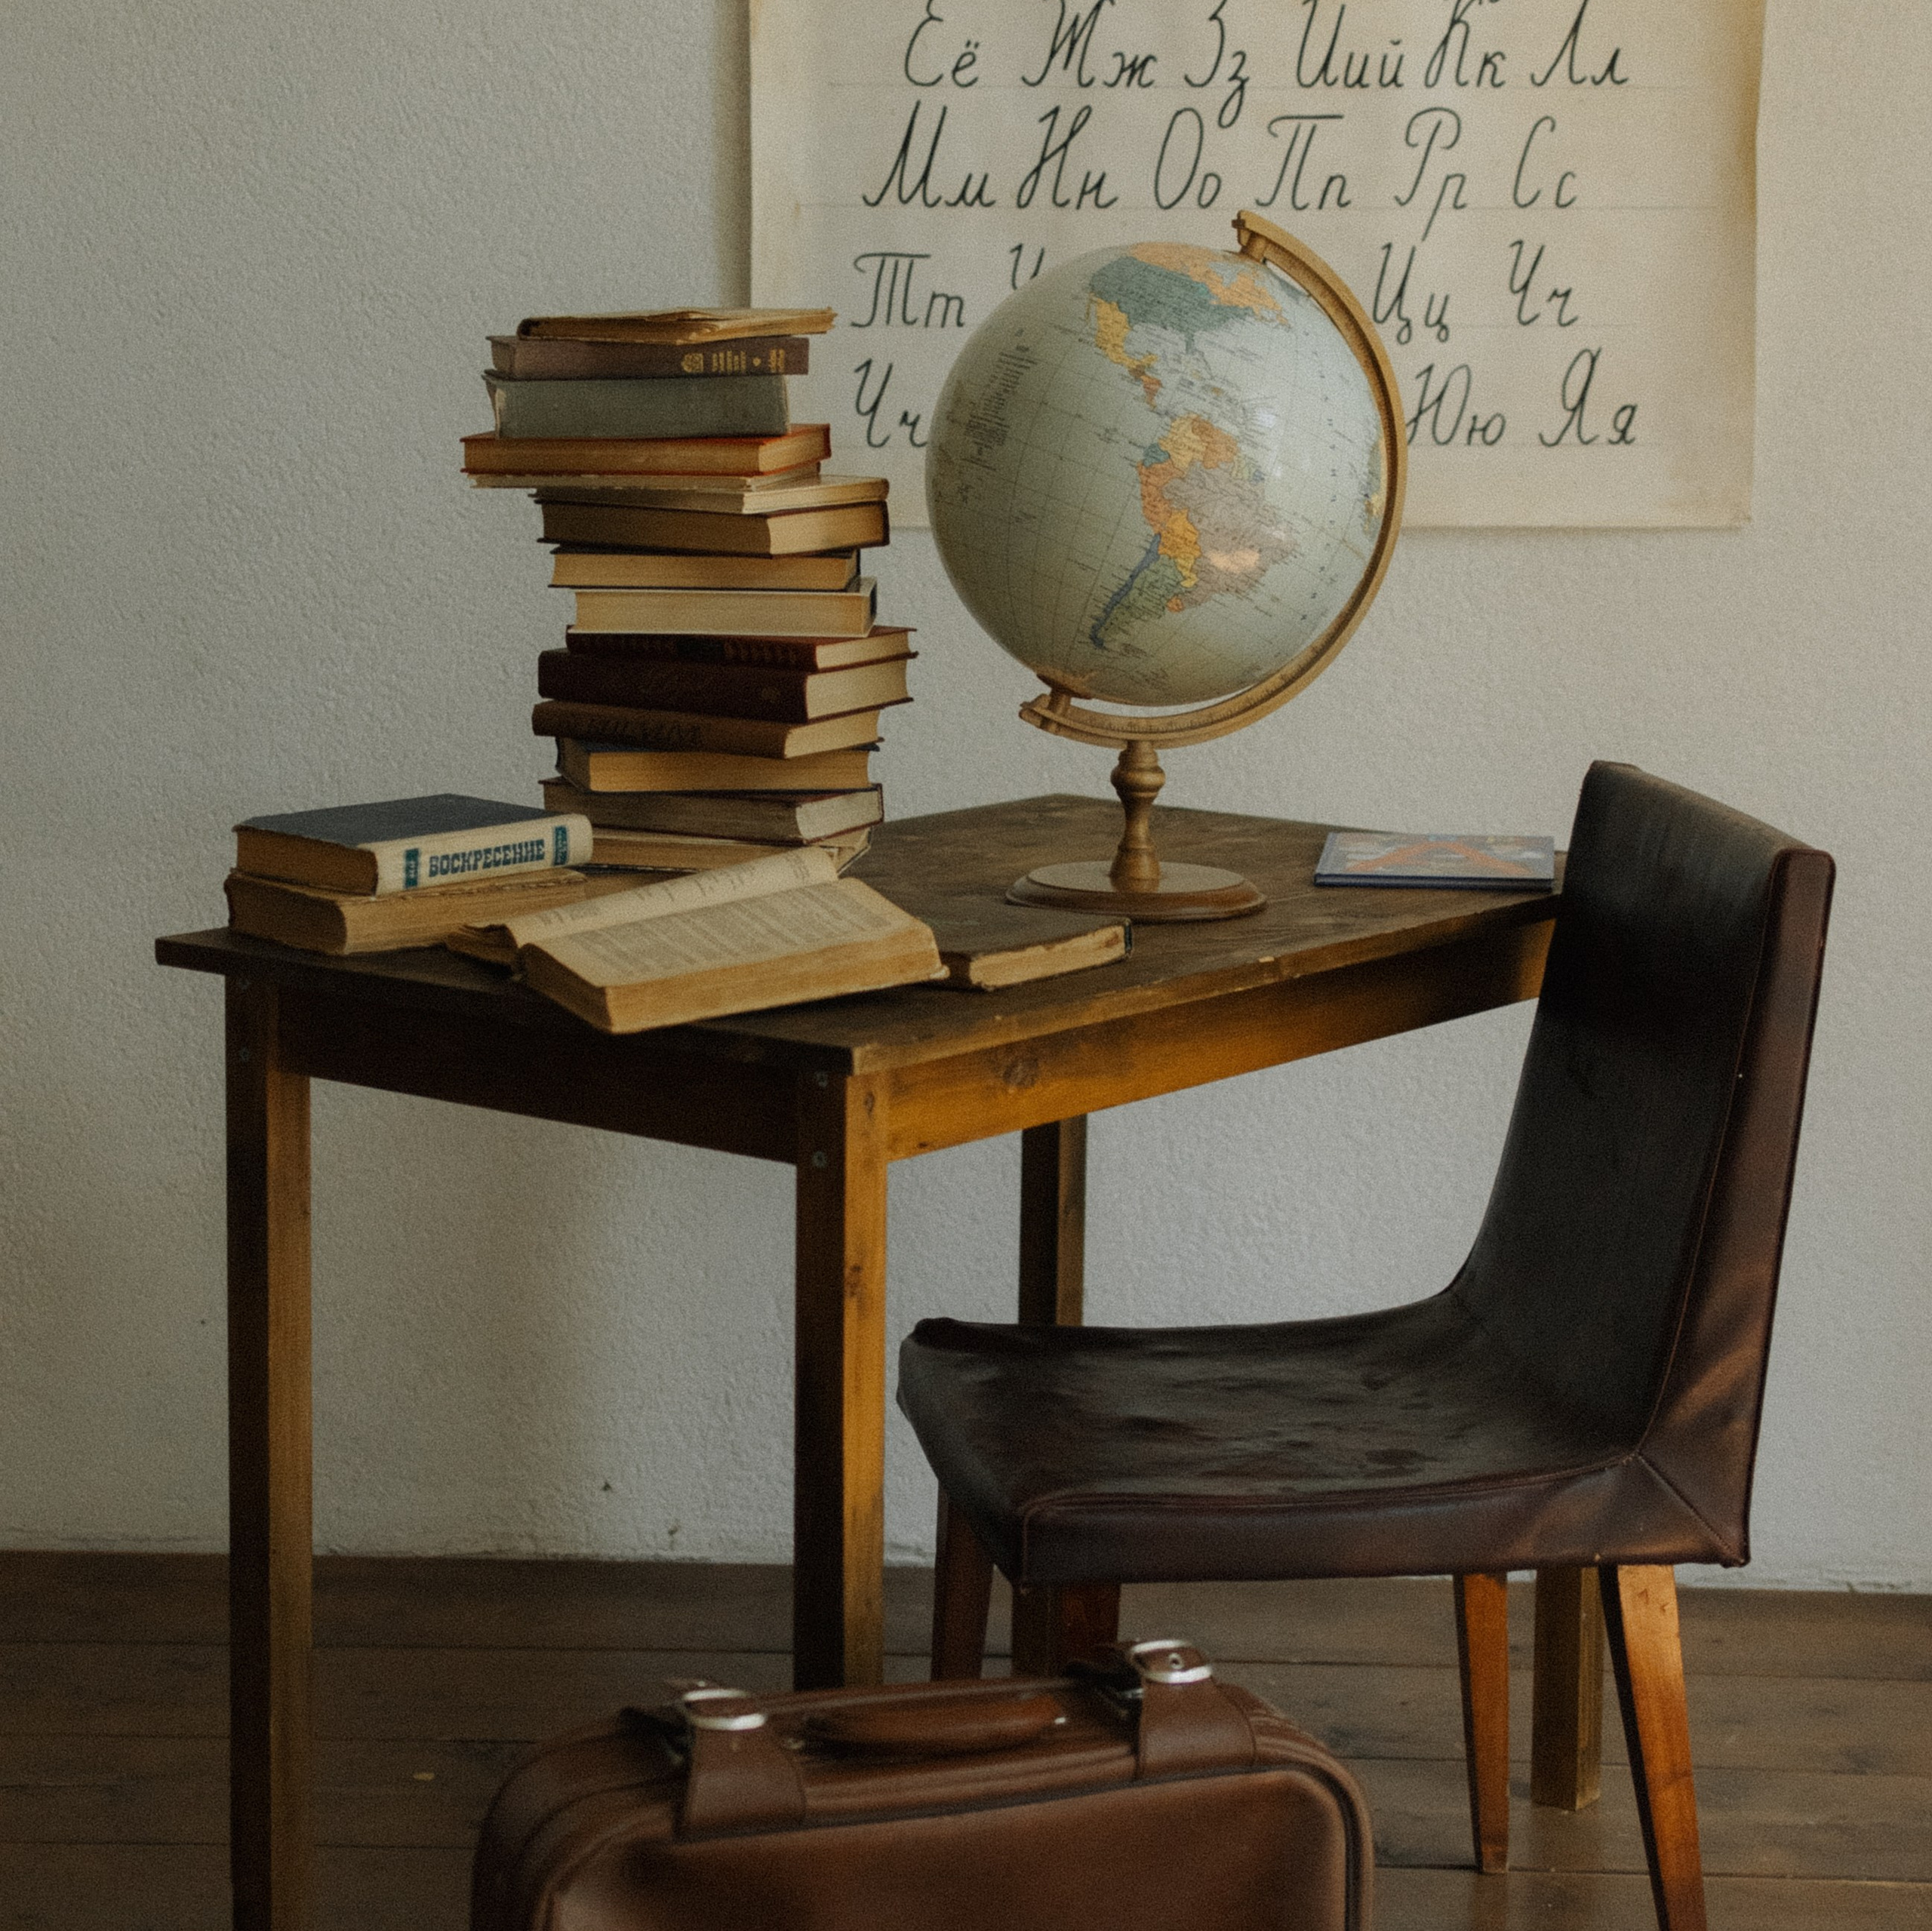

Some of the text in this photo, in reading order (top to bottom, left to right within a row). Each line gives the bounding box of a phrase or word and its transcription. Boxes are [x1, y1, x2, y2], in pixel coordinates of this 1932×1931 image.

[904, 0, 980, 88] Её
[1020, 0, 1158, 89] Жж
[1183, 0, 1250, 129] Зз
[1424, 0, 1506, 89] Кк
[1530, 0, 1629, 88] Лл
[862, 100, 1576, 241] Мм Нн Оо Пп Рр Сс
[851, 252, 964, 328] Тт
[1373, 242, 1450, 345] Цц
[1509, 239, 1578, 327] Чч
[854, 358, 927, 448] Чч
[1406, 364, 1506, 447] Юю
[1538, 348, 1638, 448] Яя
[429, 838, 546, 878] ВОСКРЕСЕНИЕ
